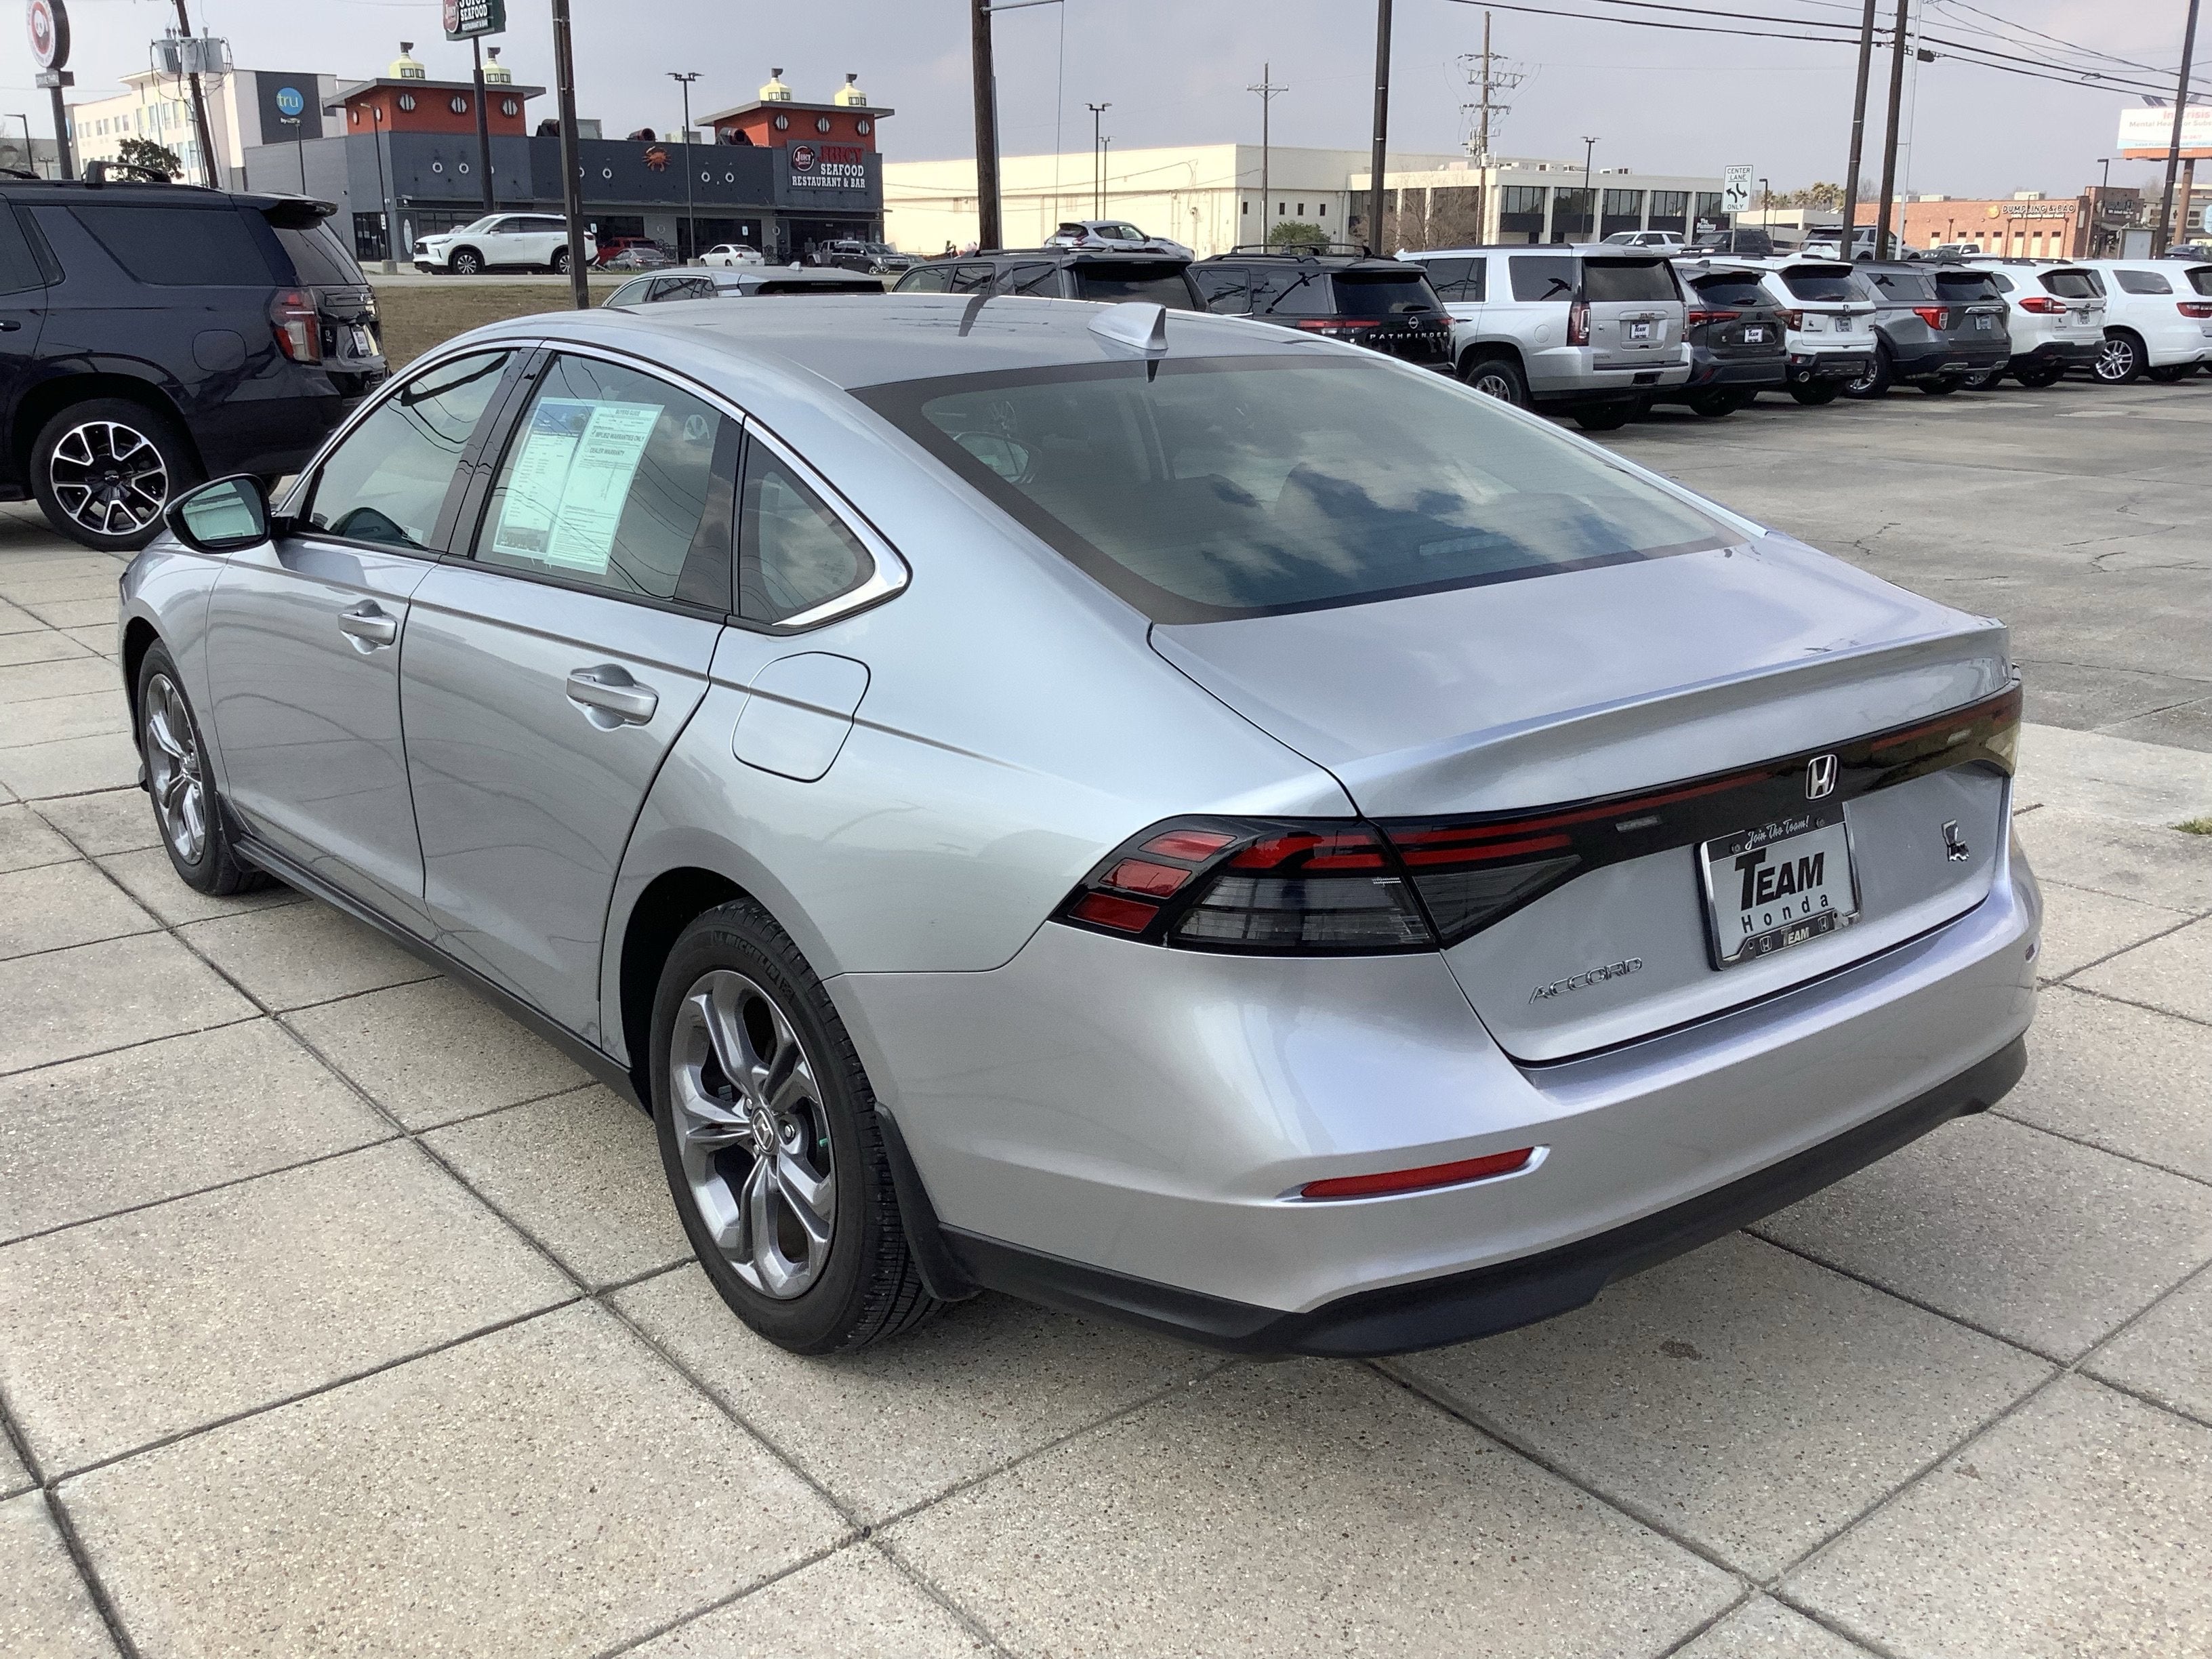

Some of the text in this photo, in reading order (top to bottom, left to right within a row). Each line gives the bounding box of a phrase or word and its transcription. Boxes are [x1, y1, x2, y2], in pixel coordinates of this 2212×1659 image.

[460, 4, 488, 21] SEAFOOD
[276, 93, 298, 108] tru
[820, 163, 864, 176] SEAFOOD
[792, 176, 865, 188] RESTAURANT & BAR
[2003, 205, 2047, 213] DUMPLING
[2057, 205, 2076, 213] BAO
[1744, 815, 1810, 851] Join The Team!
[1734, 847, 1824, 912] TEAM
[1780, 926, 1809, 947] TEAM
[1528, 957, 1643, 1004] ACCORD
